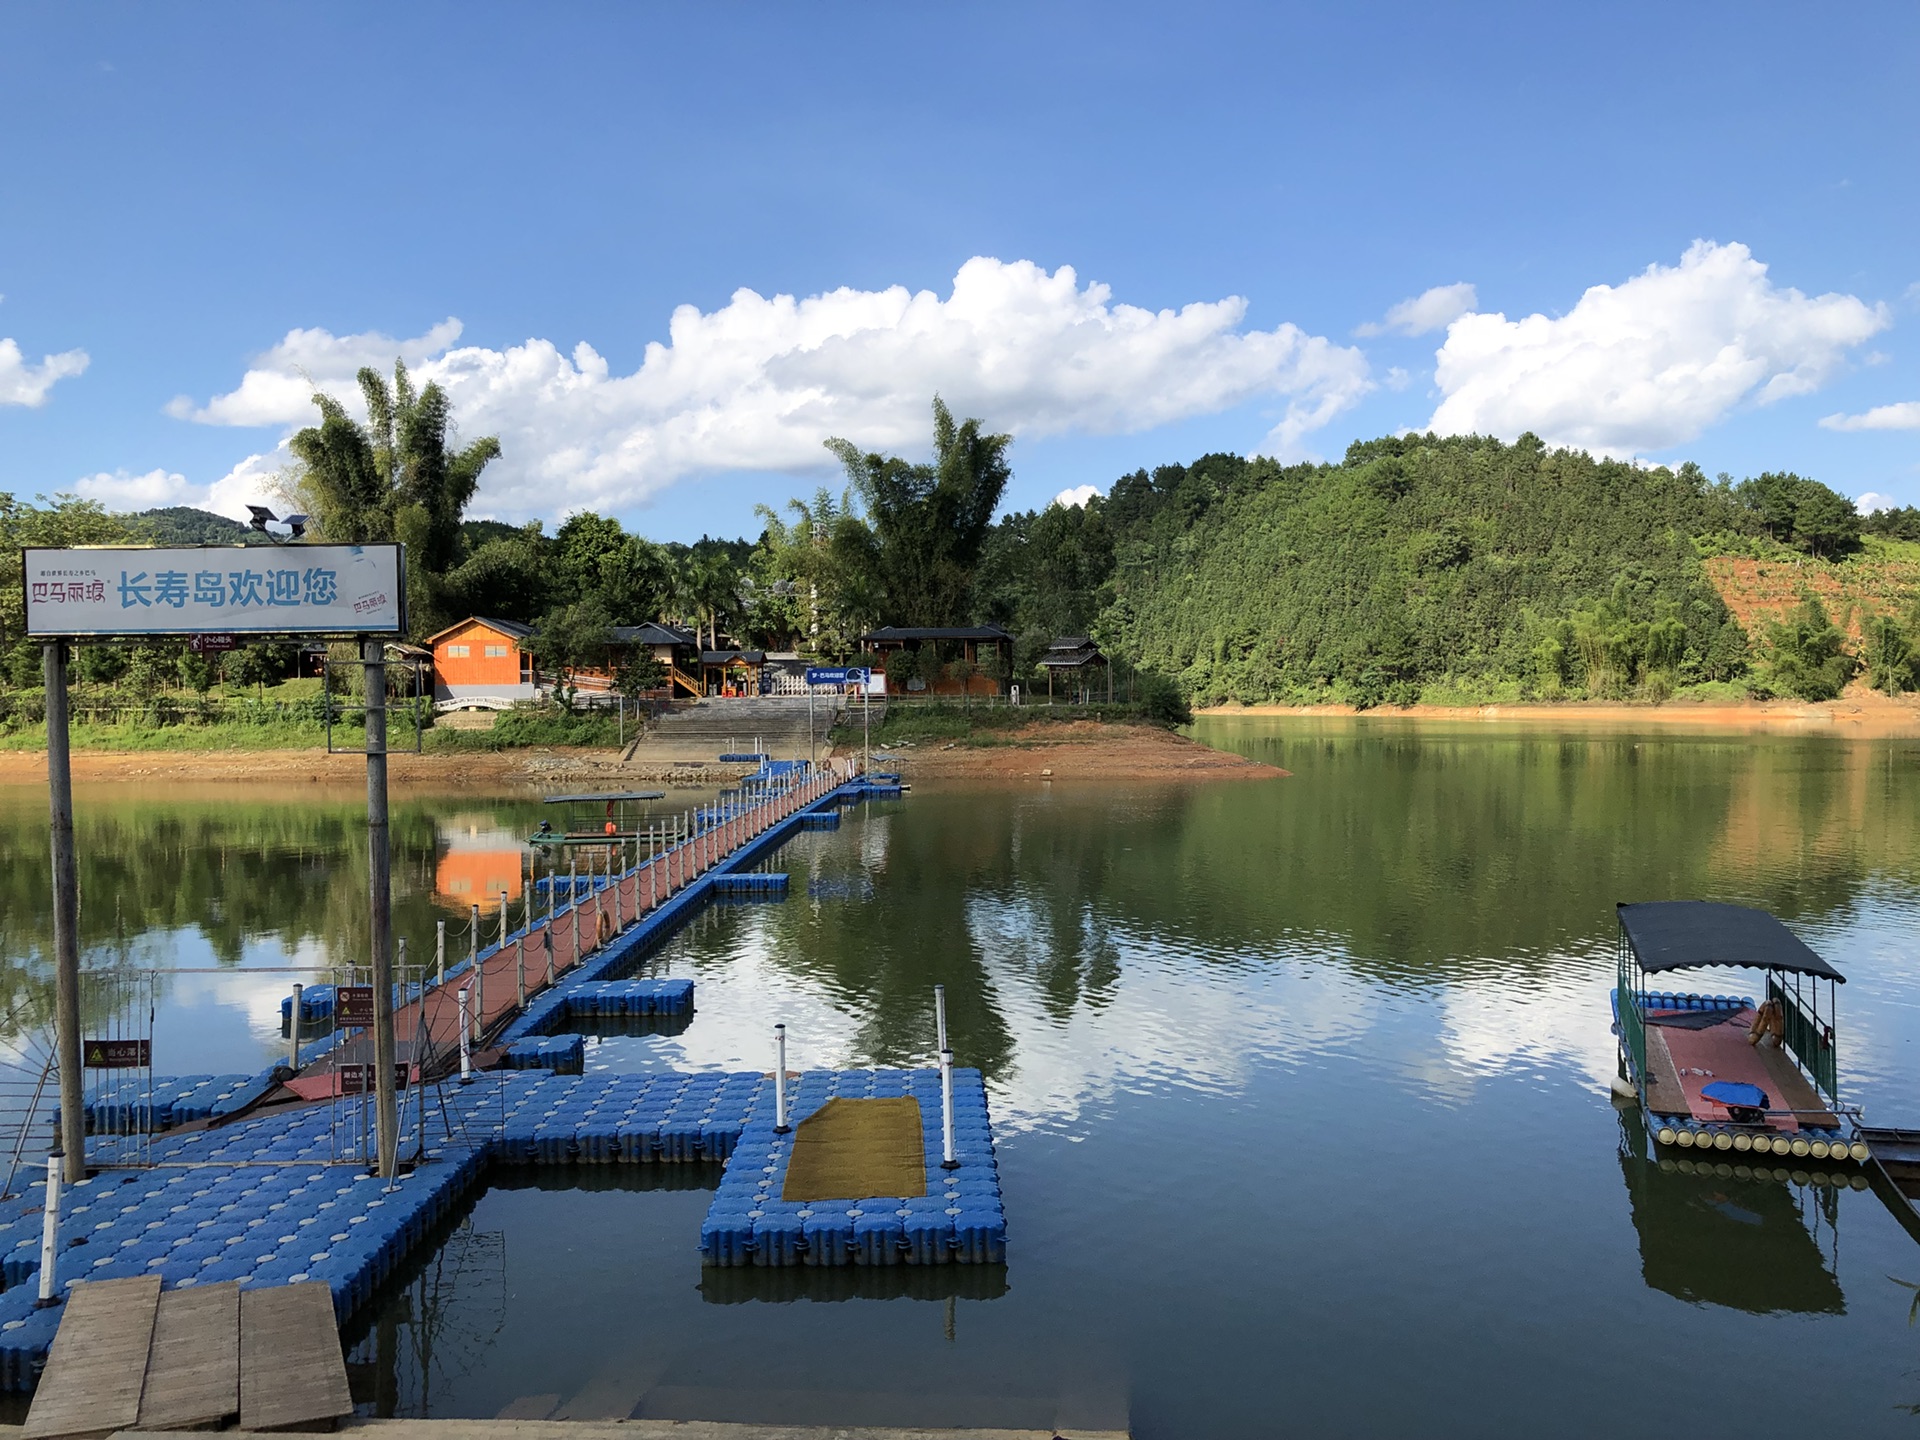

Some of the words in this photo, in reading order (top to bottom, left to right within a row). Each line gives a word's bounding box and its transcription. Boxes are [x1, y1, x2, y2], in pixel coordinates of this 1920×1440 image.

[117, 567, 338, 609] 长寿岛欢迎您
[204, 636, 232, 644] 小心碰头
